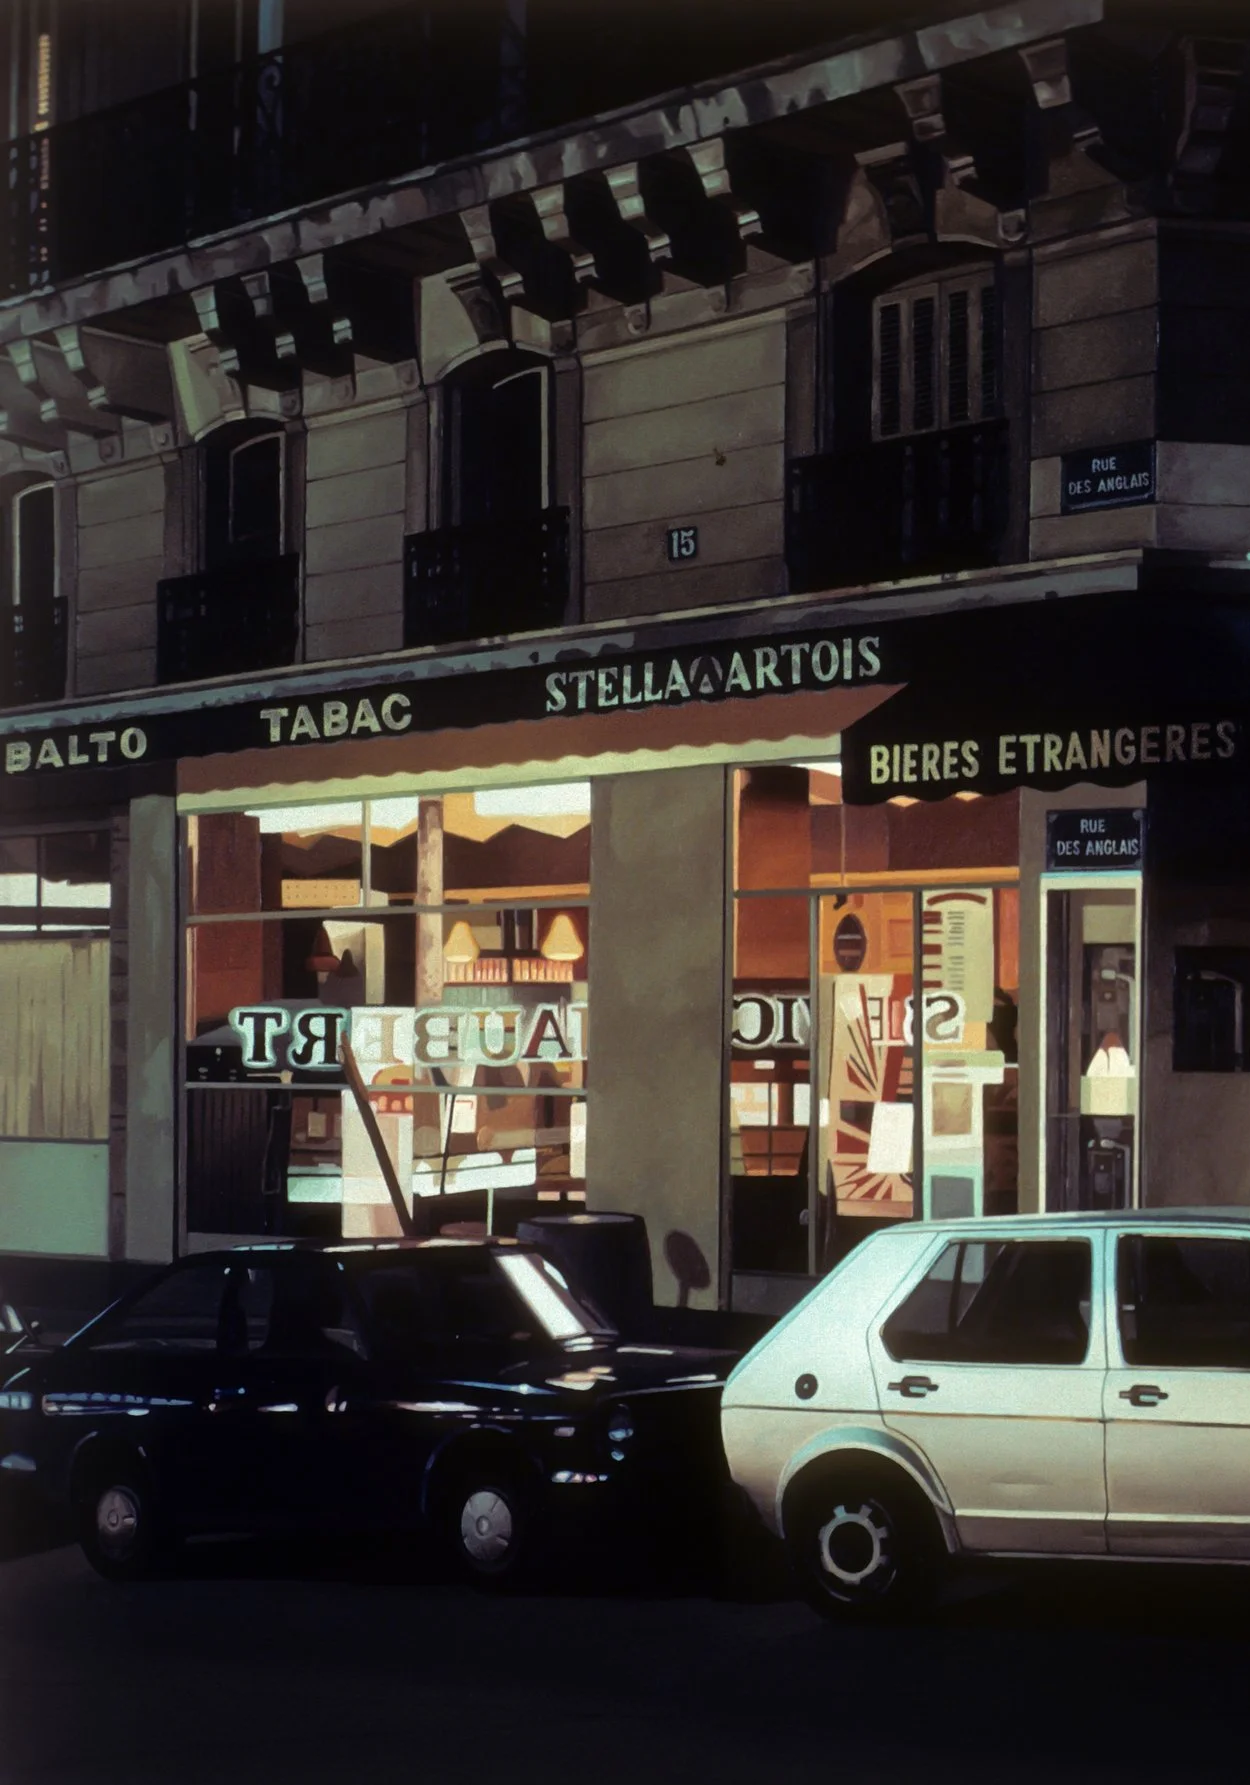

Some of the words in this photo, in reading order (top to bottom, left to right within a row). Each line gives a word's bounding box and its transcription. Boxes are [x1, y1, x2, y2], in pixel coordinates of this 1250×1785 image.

[1091, 456, 1117, 473] RUE
[1068, 479, 1092, 496] DES
[1097, 472, 1150, 494] ANGLAIS
[672, 529, 695, 558] 15
[545, 656, 691, 712] STELLA
[725, 636, 881, 693] ARTOIS
[259, 692, 413, 743] TABAC
[5, 726, 148, 774] BALTO
[870, 739, 980, 785] BIERES
[998, 720, 1236, 776] ETRANGERES
[1079, 818, 1106, 834] RUE
[1056, 840, 1080, 857] DES
[1085, 838, 1139, 856] ANGLAIS
